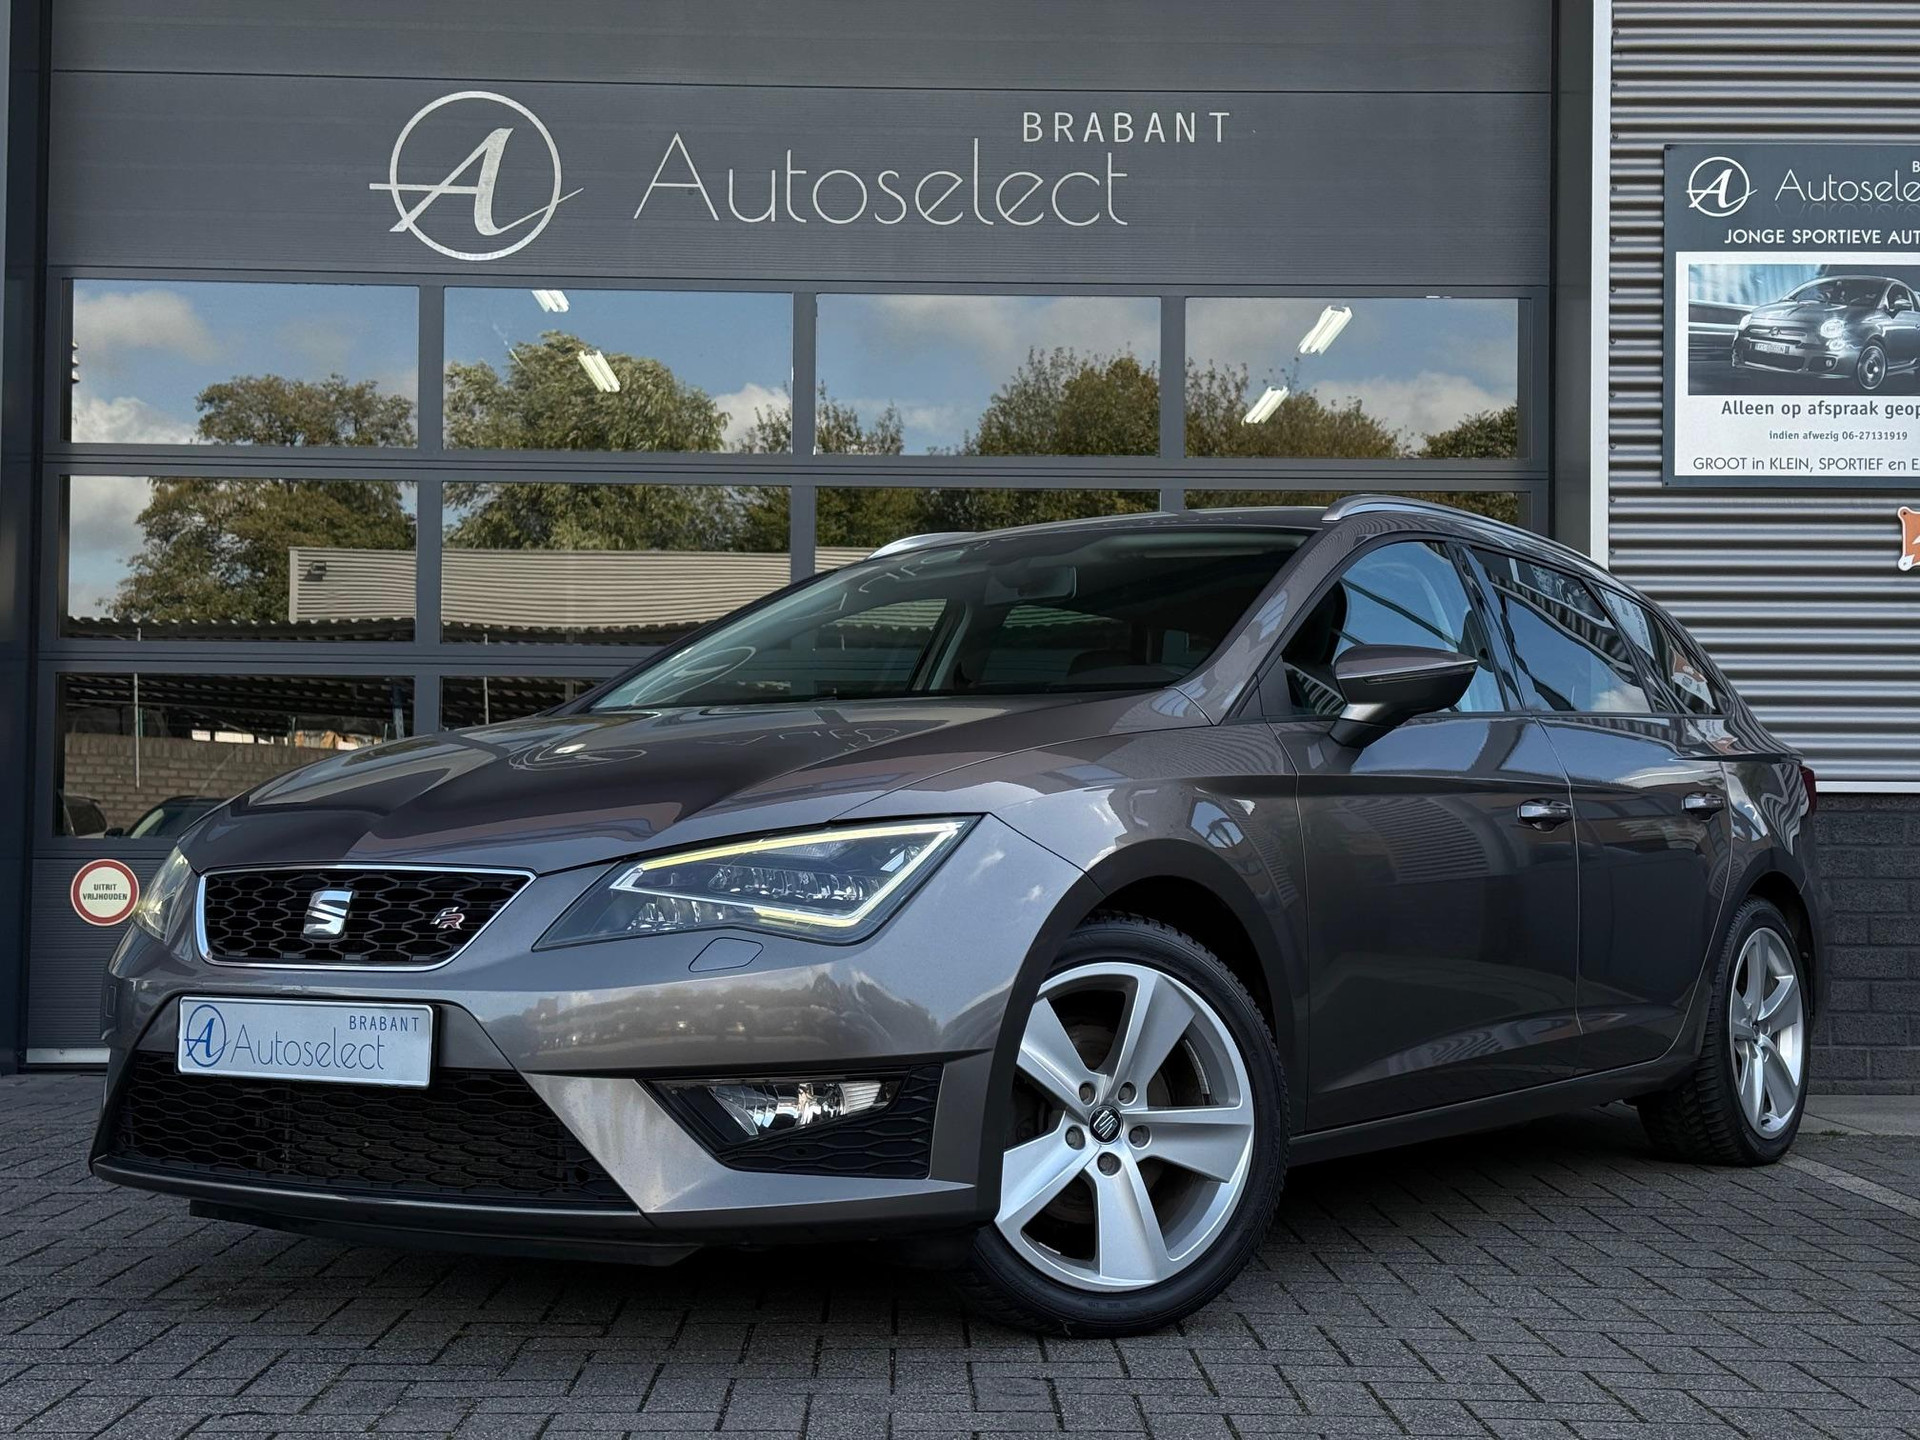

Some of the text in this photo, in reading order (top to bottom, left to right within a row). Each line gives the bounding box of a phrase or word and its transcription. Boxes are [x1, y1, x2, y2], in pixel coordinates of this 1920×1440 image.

[1022, 111, 1230, 143] BRABANT
[634, 132, 1129, 226] Autoselect
[1775, 169, 1920, 202] Autosele
[1724, 229, 1920, 244] JONGE SPORTIEVE AUT
[1721, 400, 1774, 415] Alleen
[1781, 404, 1801, 419] op
[1808, 400, 1879, 419] afspraak
[1803, 430, 1839, 442] afwezig
[1842, 431, 1908, 441] 06-27131919
[1693, 457, 1747, 470] GROOT
[1752, 457, 1765, 470] in
[1769, 457, 1813, 473] KLEIN,
[1819, 457, 1884, 471] SPORTIEF
[1888, 460, 1906, 471] en
[93, 883, 118, 891] UITRIT
[349, 1015, 419, 1032] BRABANT
[230, 1024, 384, 1070] Autoselect
